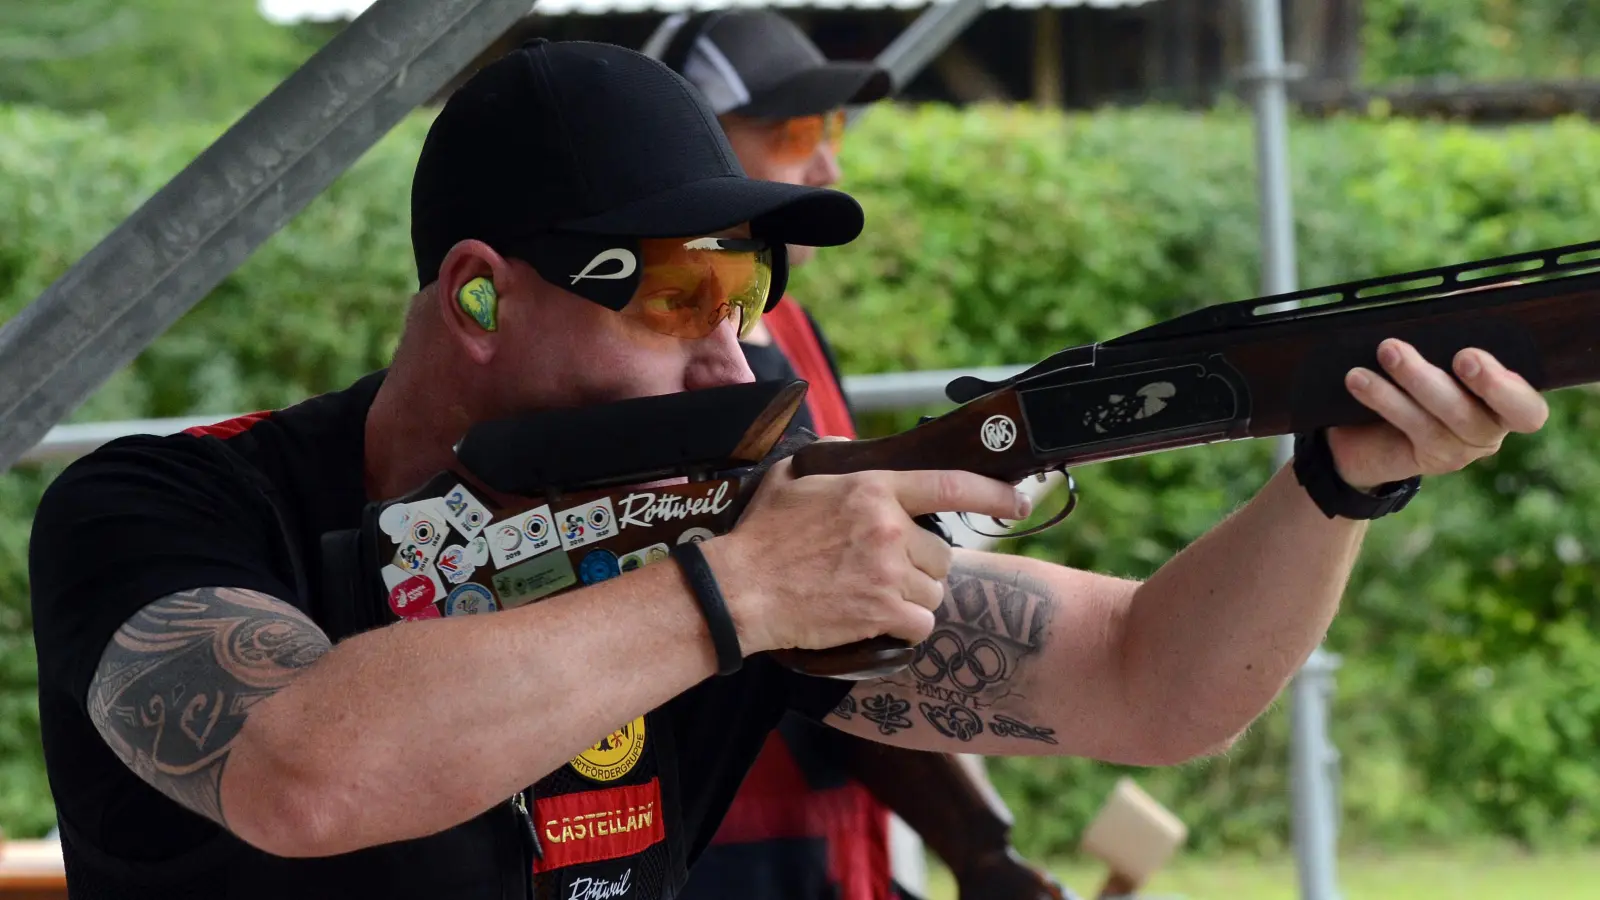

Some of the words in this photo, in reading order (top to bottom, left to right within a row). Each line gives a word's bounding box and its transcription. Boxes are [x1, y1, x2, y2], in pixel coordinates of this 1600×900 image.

[618, 481, 732, 529] Rottweil
[533, 540, 549, 549] ISSF
[505, 550, 522, 561] 2019
